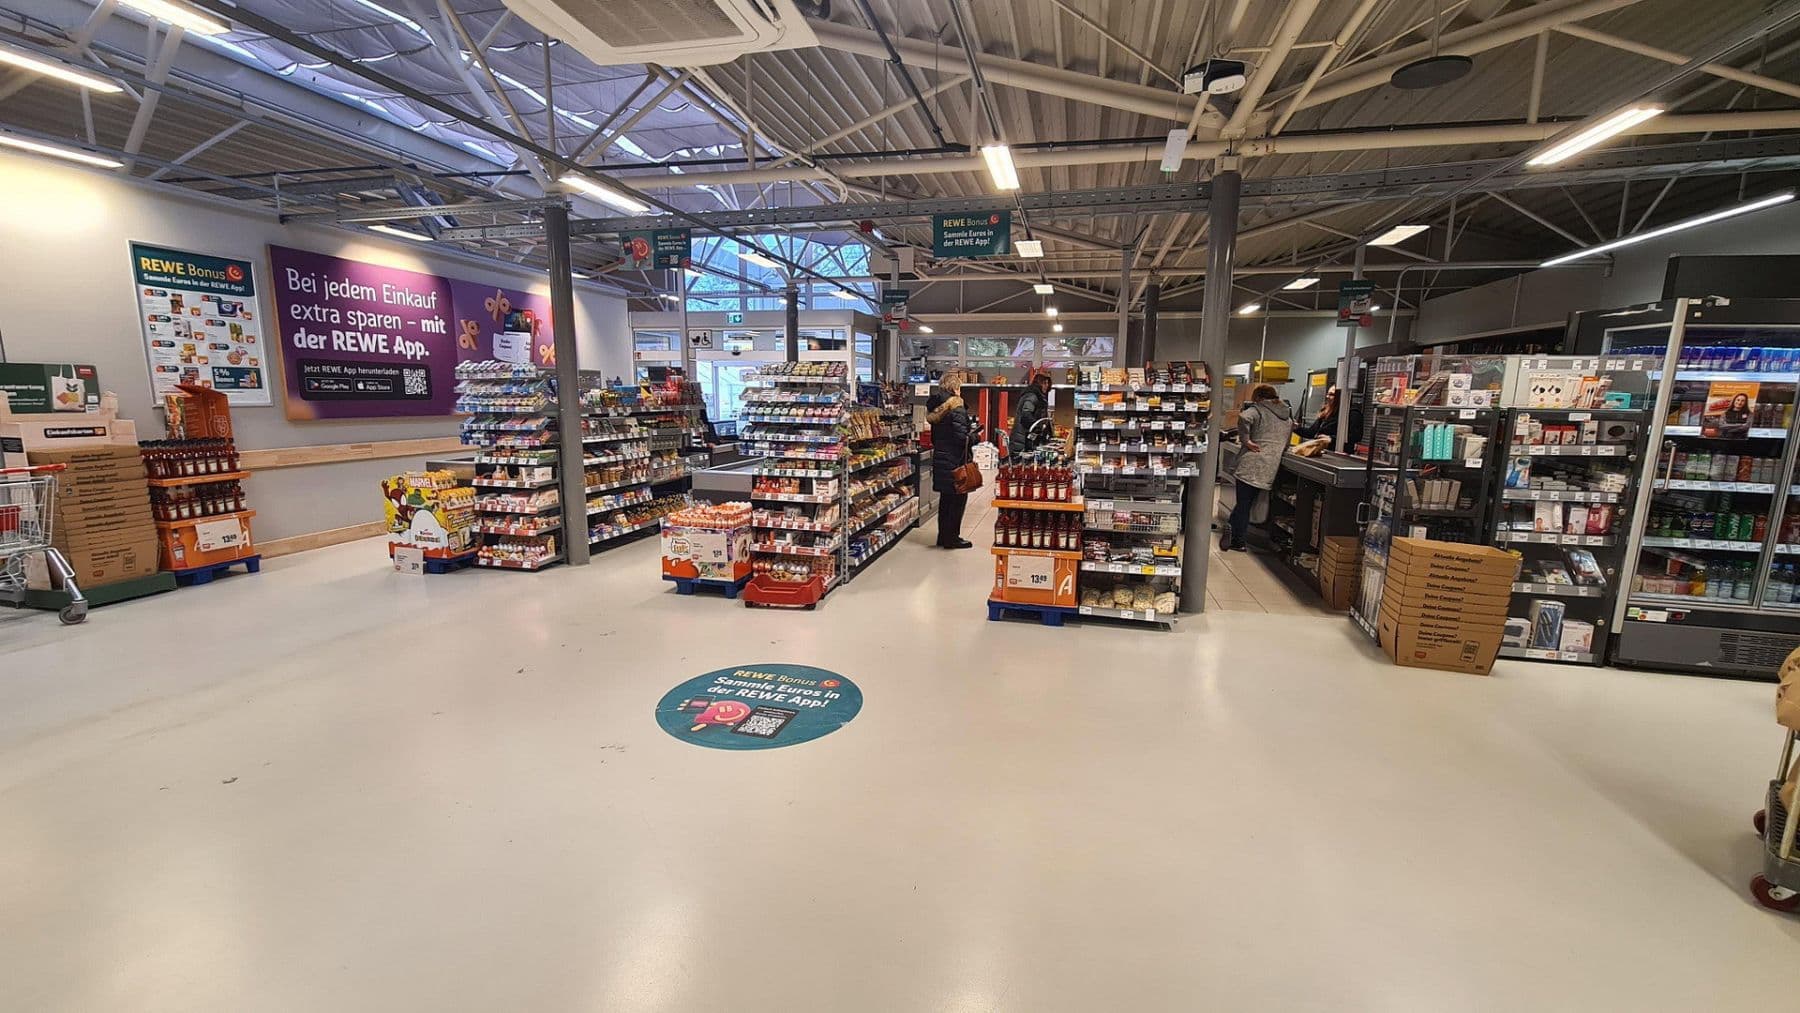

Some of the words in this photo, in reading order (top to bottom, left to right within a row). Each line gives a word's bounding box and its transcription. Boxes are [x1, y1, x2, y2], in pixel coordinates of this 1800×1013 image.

[944, 219, 966, 228] REWE
[967, 217, 988, 226] Bonus
[975, 238, 990, 247] App!
[140, 257, 185, 275] REWE
[188, 263, 226, 280] Bonus
[144, 273, 171, 282] Sammle
[286, 268, 316, 293] Bei
[323, 274, 377, 301] jedem
[382, 284, 437, 310] Einkauf
[290, 303, 340, 323] extra
[347, 310, 401, 331] sparen
[421, 316, 446, 334] mit
[294, 327, 327, 349] der
[332, 330, 389, 354] REWE
[393, 335, 430, 360] App.
[304, 365, 320, 373] Jetzt
[344, 367, 356, 375] App
[410, 478, 431, 488] MARVEL
[714, 676, 775, 691] Sammle
[777, 684, 823, 698] Euros
[825, 689, 841, 699] in
[733, 670, 776, 681] REWE
[777, 675, 817, 686] Bonus
[707, 685, 734, 695] der
[736, 688, 788, 703] REWE
[788, 695, 828, 709] App!
